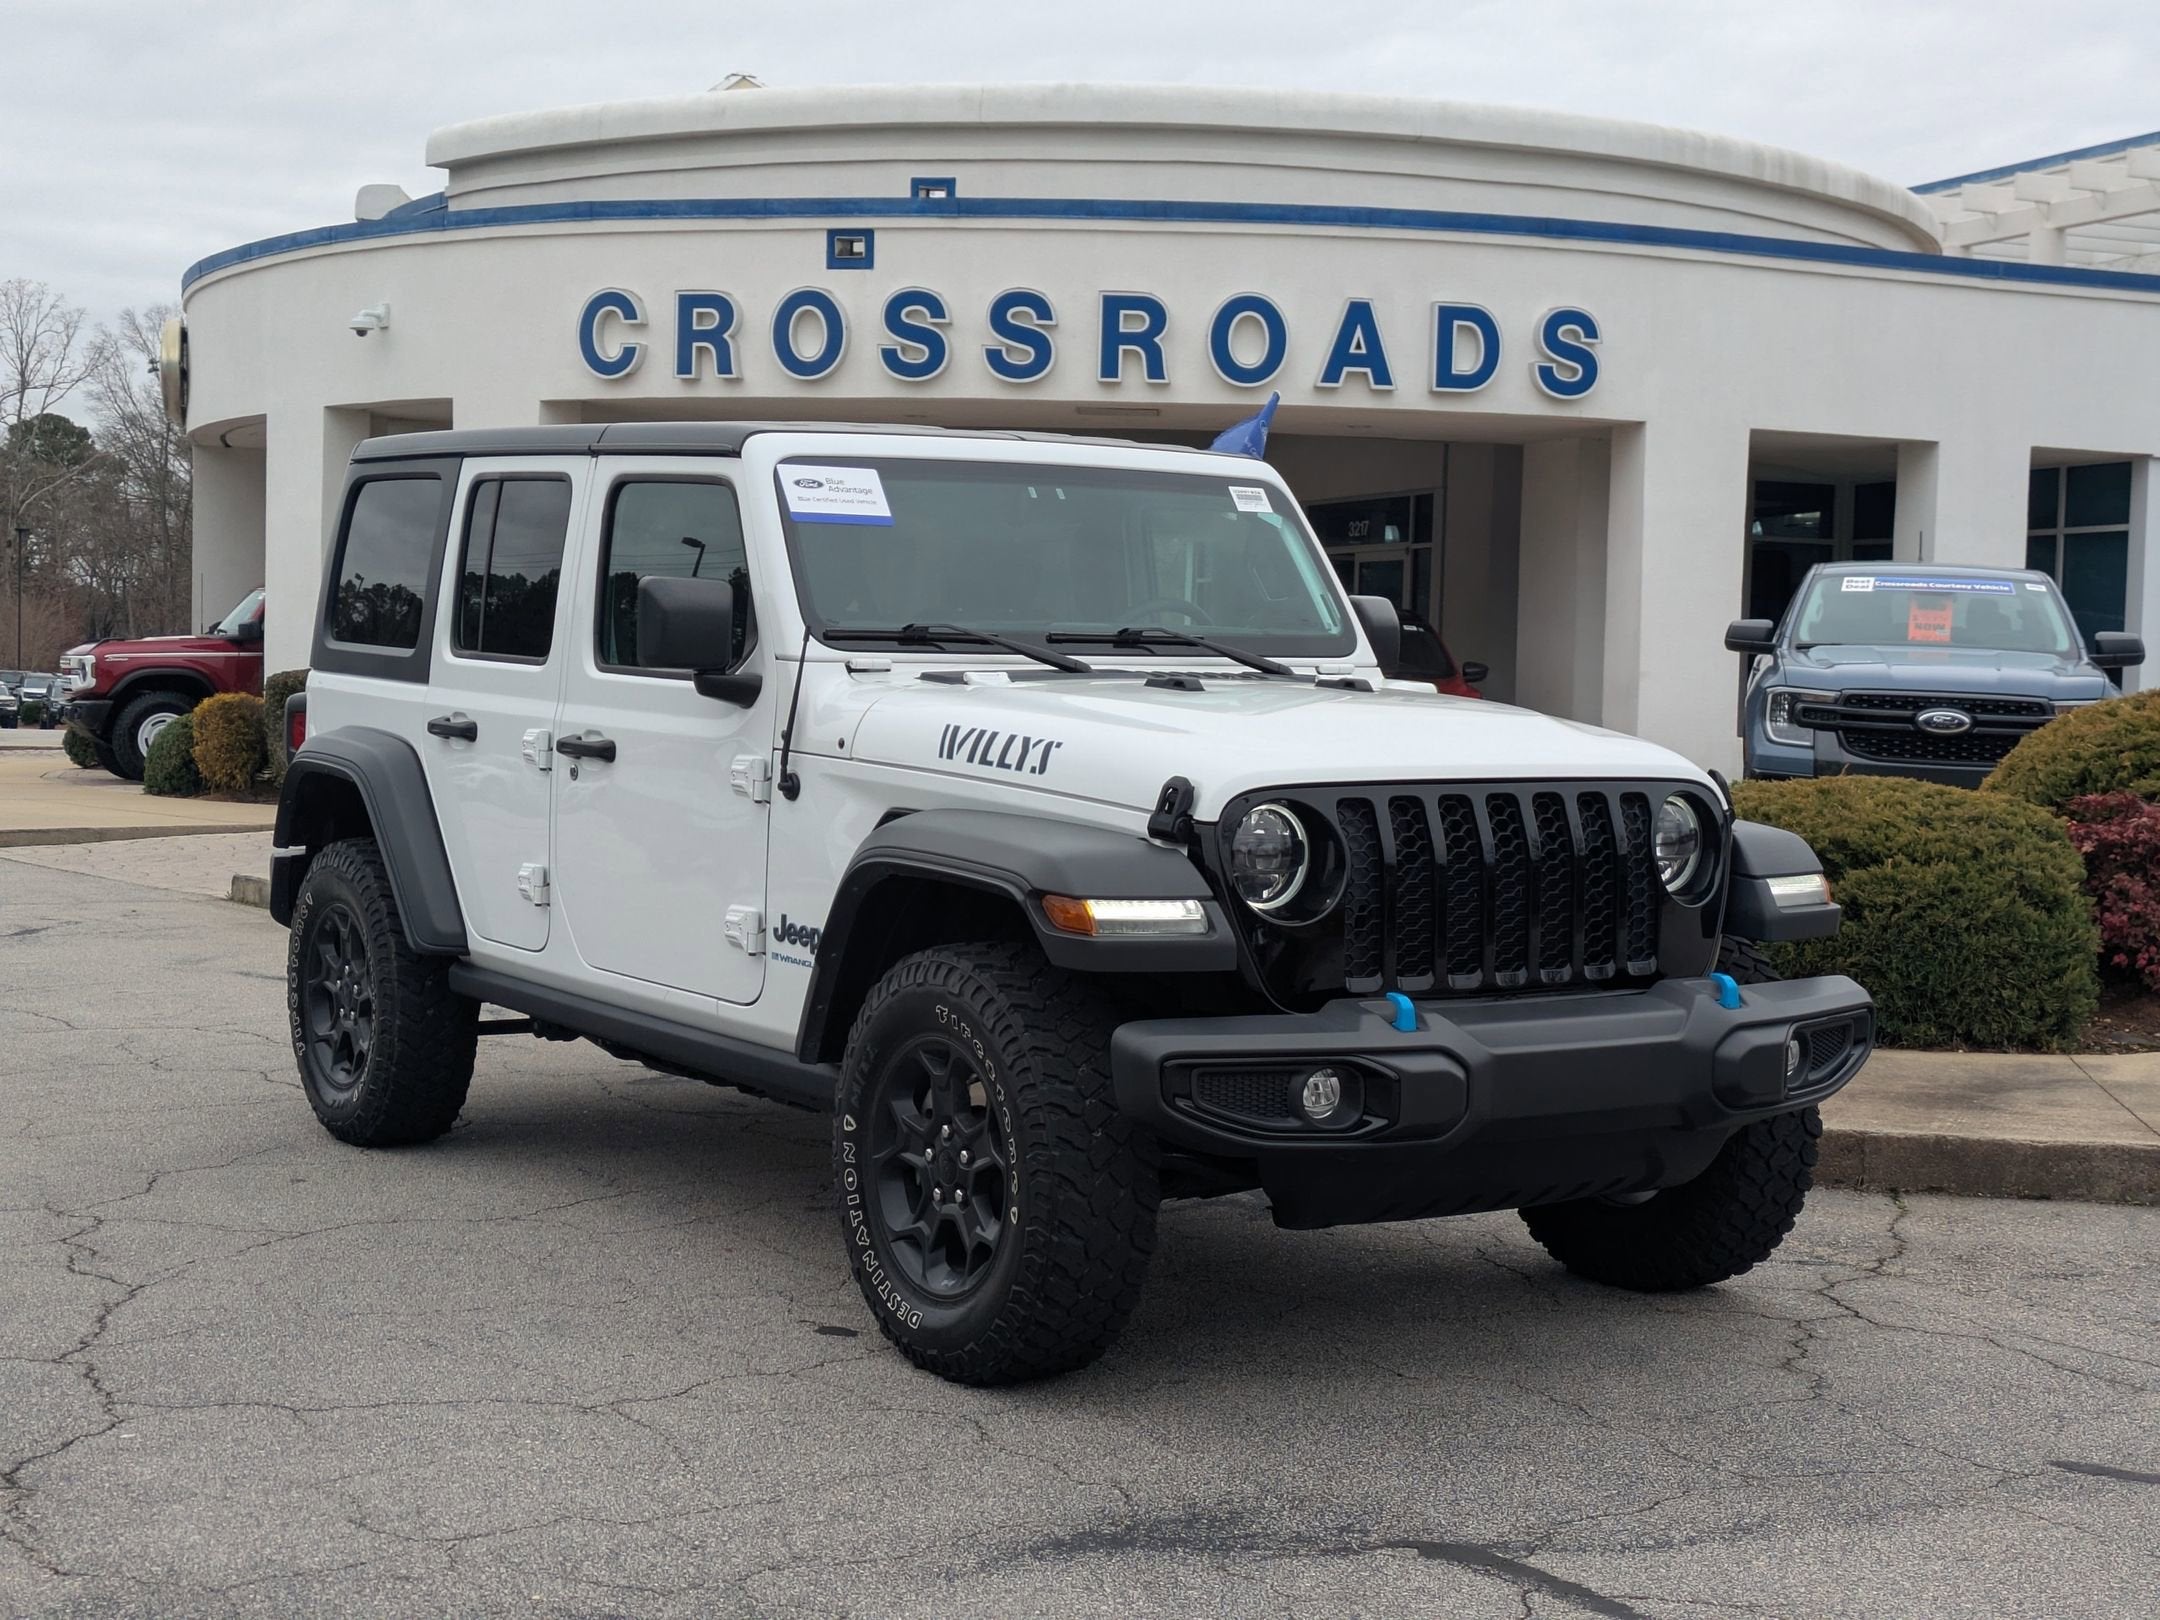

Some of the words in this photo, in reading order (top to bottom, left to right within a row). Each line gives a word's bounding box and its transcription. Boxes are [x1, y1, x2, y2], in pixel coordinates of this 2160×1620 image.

[576, 287, 1603, 400] CROSSROADS
[828, 486, 873, 495] Advantage
[1348, 520, 1369, 537] 3217
[1929, 582, 1972, 590] Courtesy
[1973, 583, 2010, 591] Vehicle
[938, 723, 1063, 775] WILLYS
[773, 913, 821, 955] Jeep
[843, 1142, 924, 1330] DESTINATION
